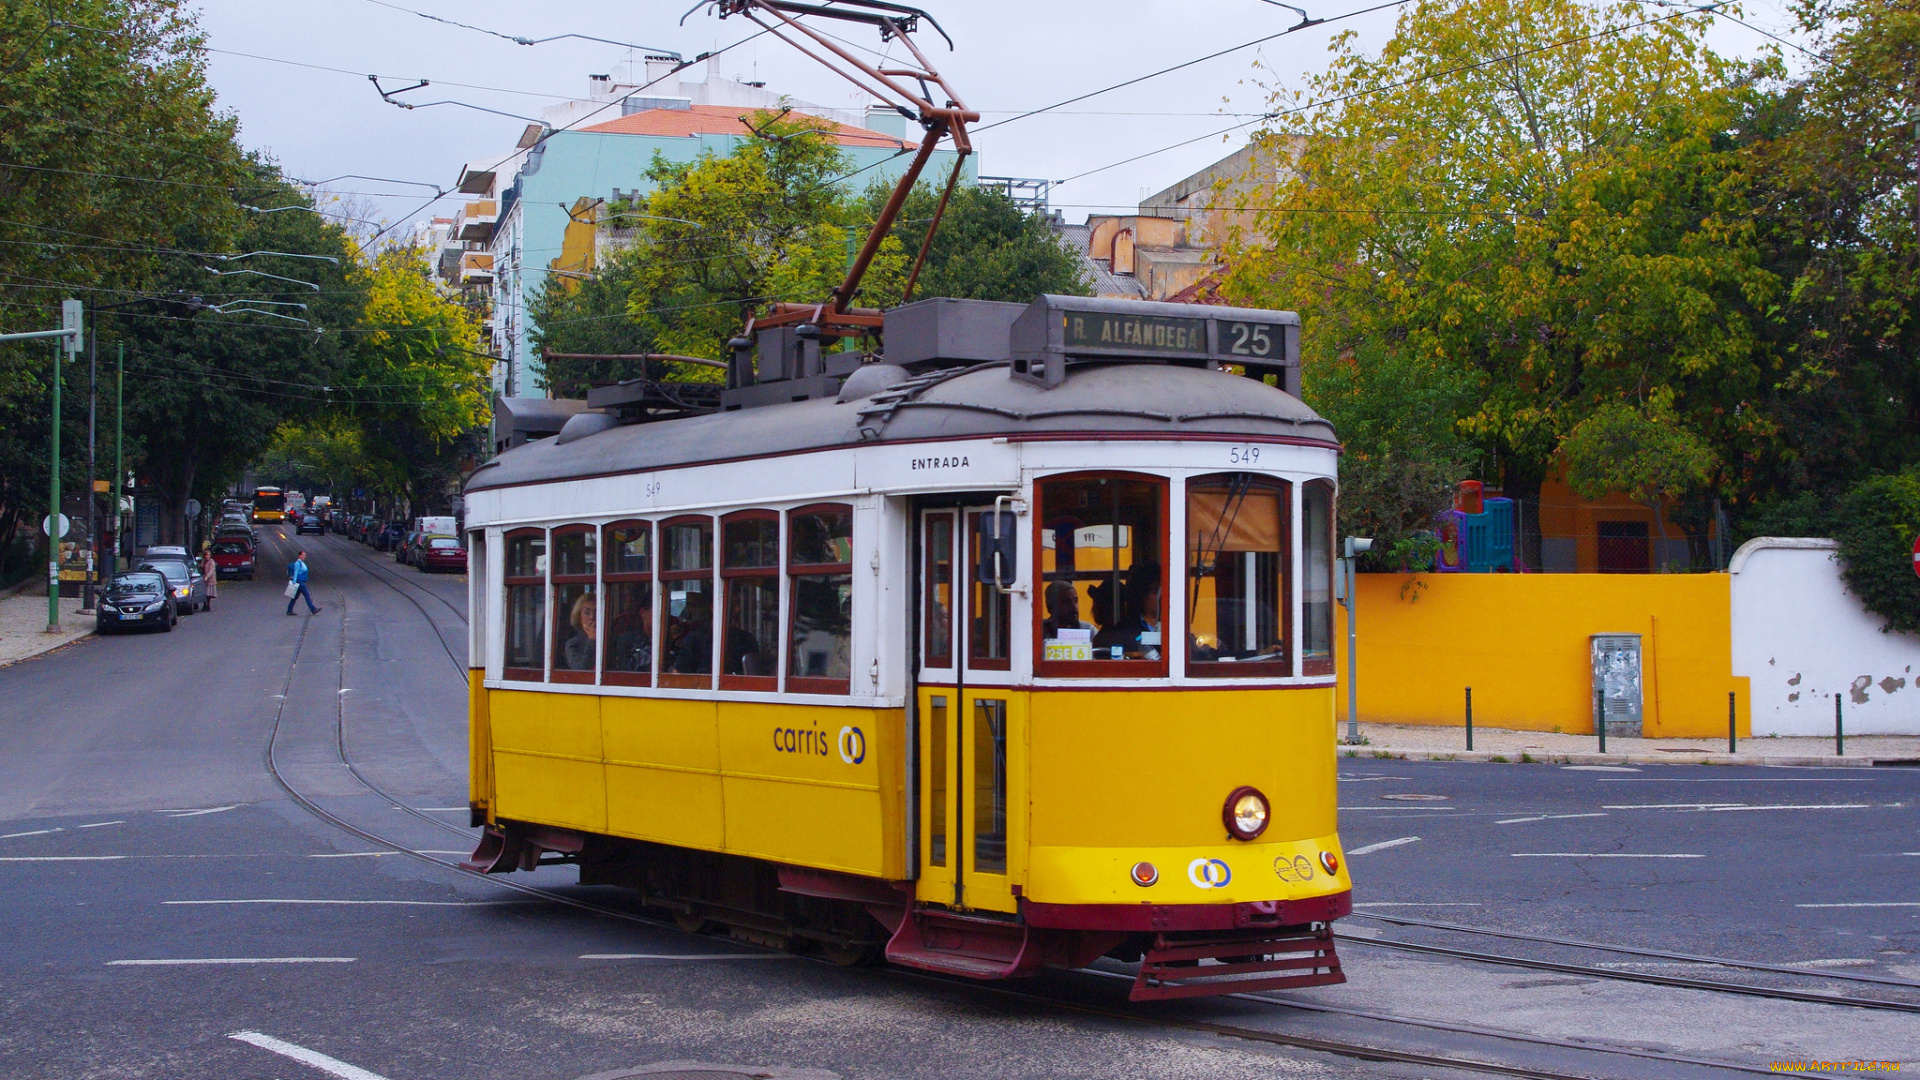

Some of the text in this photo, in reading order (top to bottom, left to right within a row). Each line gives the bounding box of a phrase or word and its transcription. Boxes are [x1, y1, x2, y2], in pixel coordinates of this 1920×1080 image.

[1073, 317, 1087, 340] R.
[1230, 322, 1271, 356] 25
[911, 456, 970, 470] ENTRADA
[1230, 447, 1260, 464] 549
[646, 481, 661, 498] 549
[1048, 647, 1071, 660] 25E
[1076, 647, 1086, 660] 6
[773, 719, 829, 756] carris
